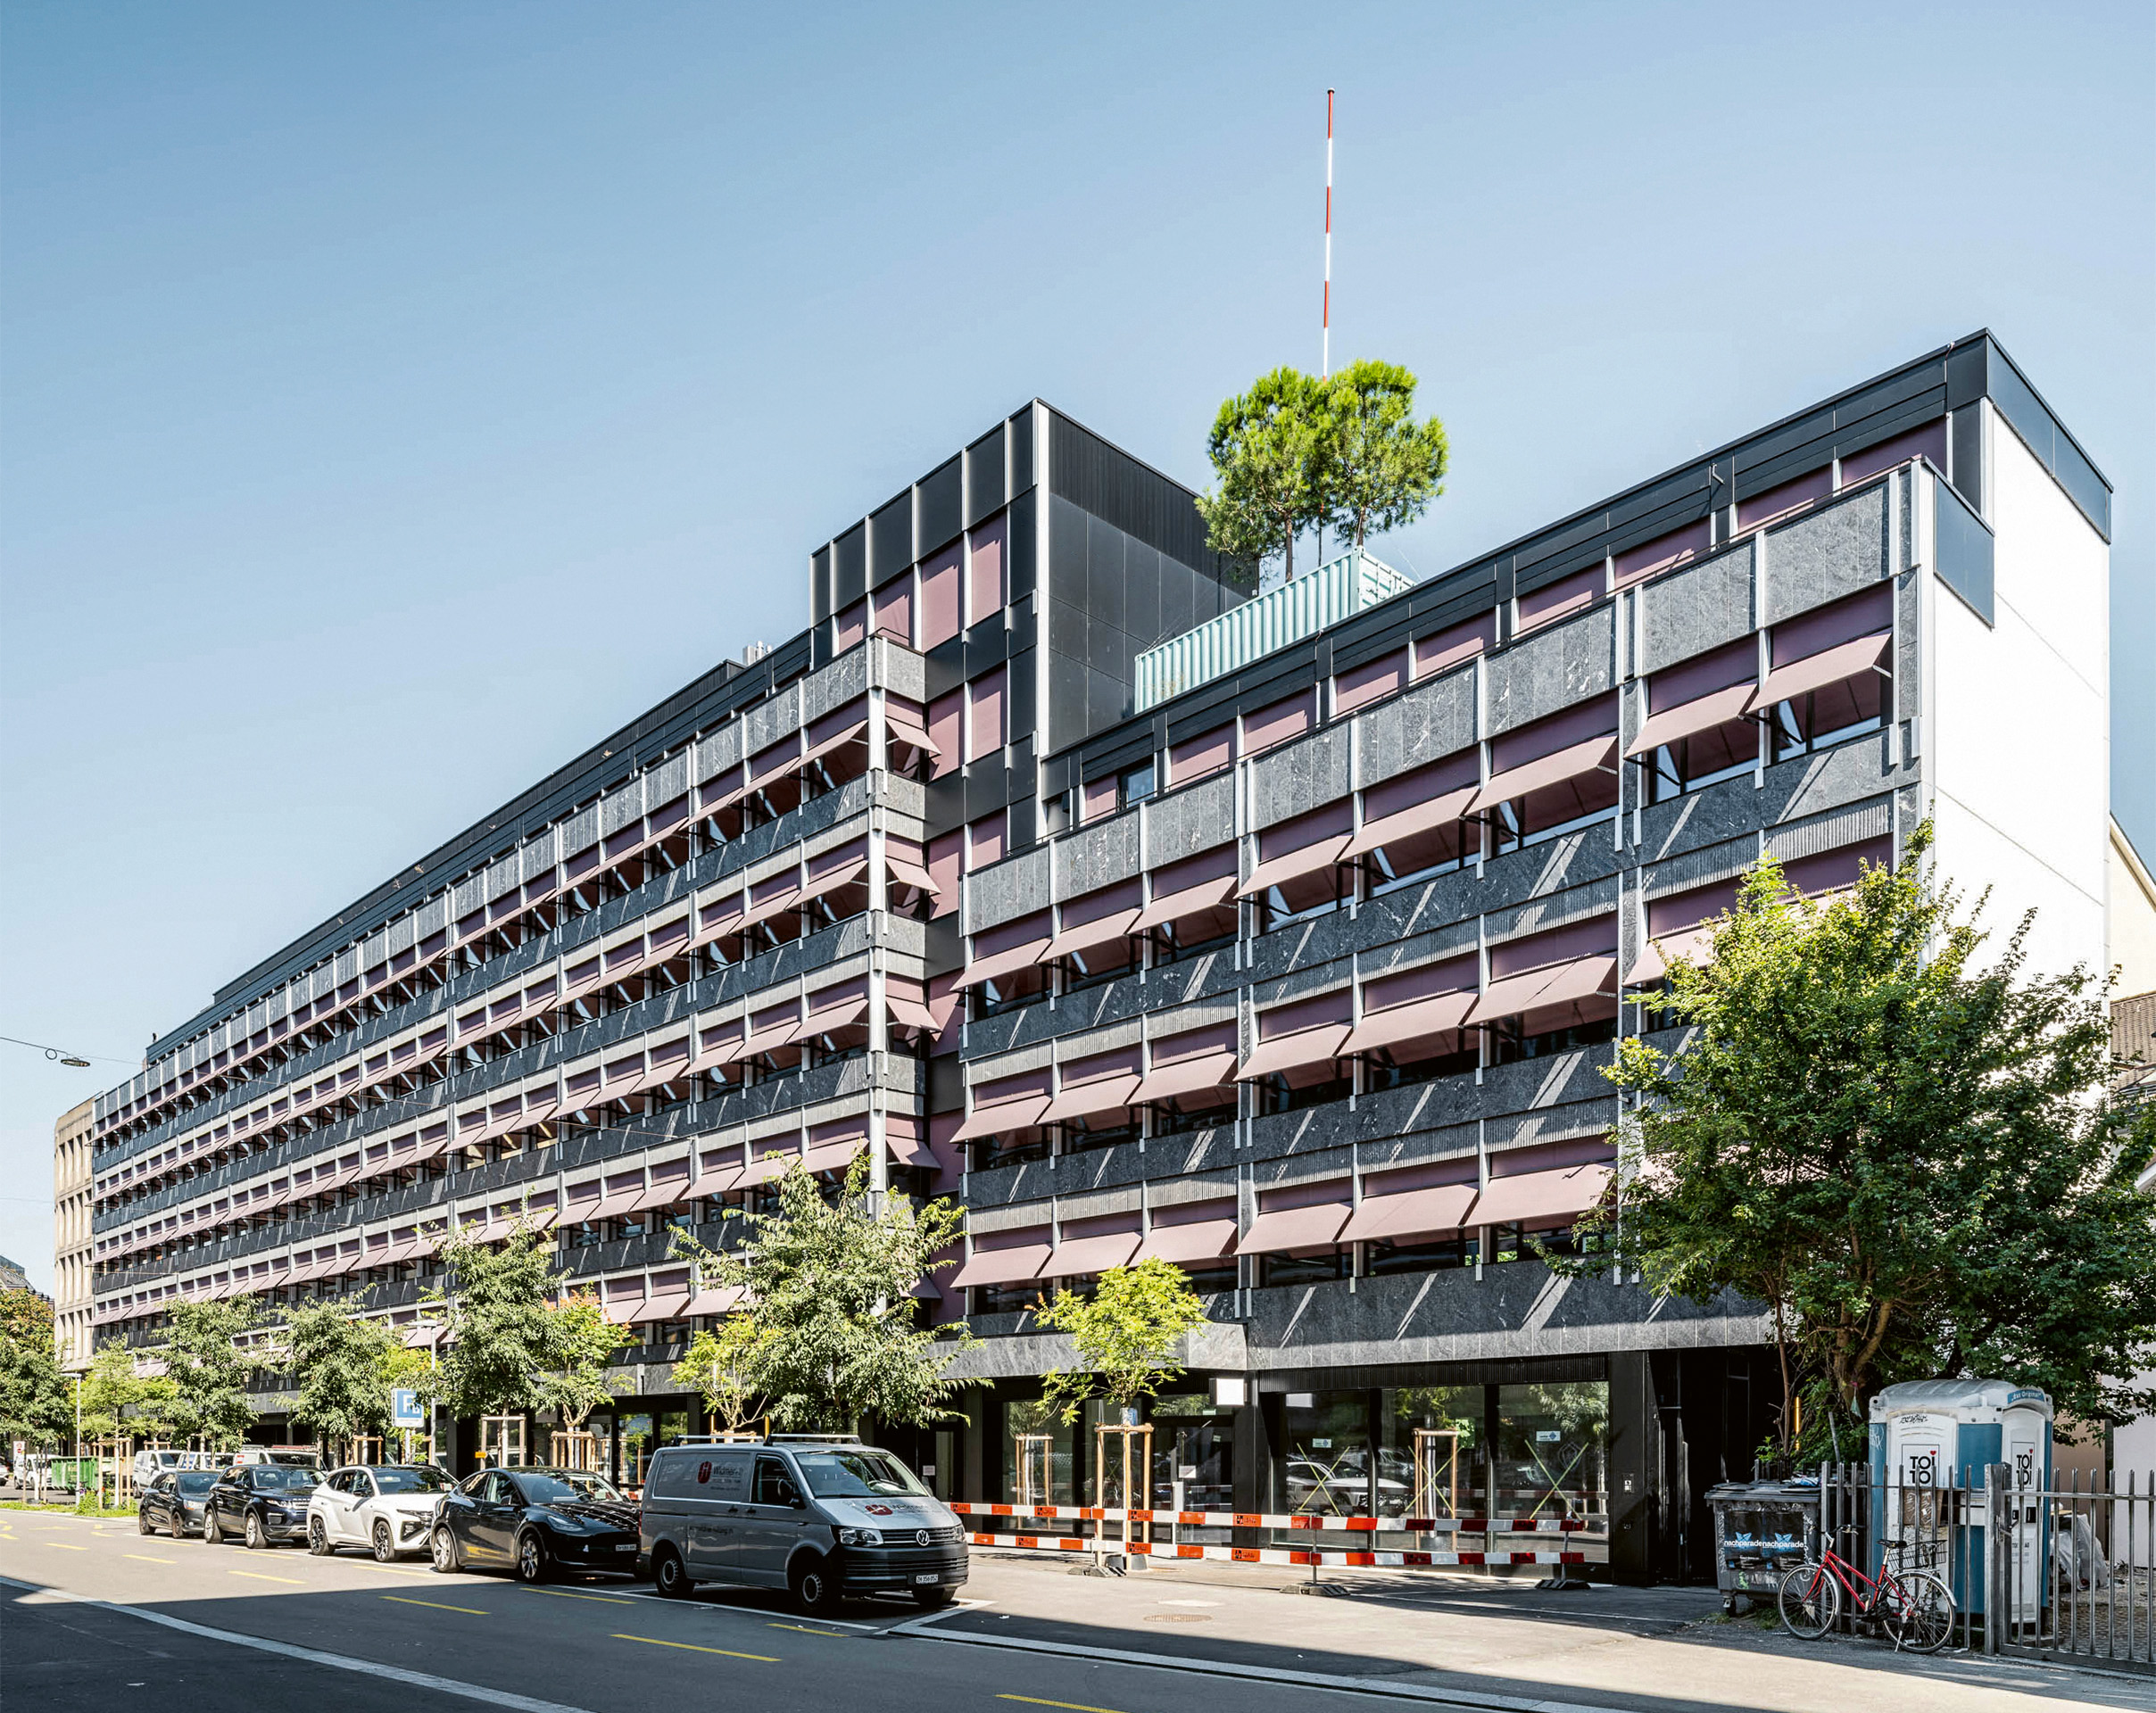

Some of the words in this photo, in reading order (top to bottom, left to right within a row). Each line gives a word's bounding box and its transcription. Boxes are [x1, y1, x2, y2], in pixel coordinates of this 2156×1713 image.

[2016, 1454, 2033, 1469] TOI
[1910, 1470, 1936, 1485] TO
[1762, 1540, 1804, 1548] nachparade
